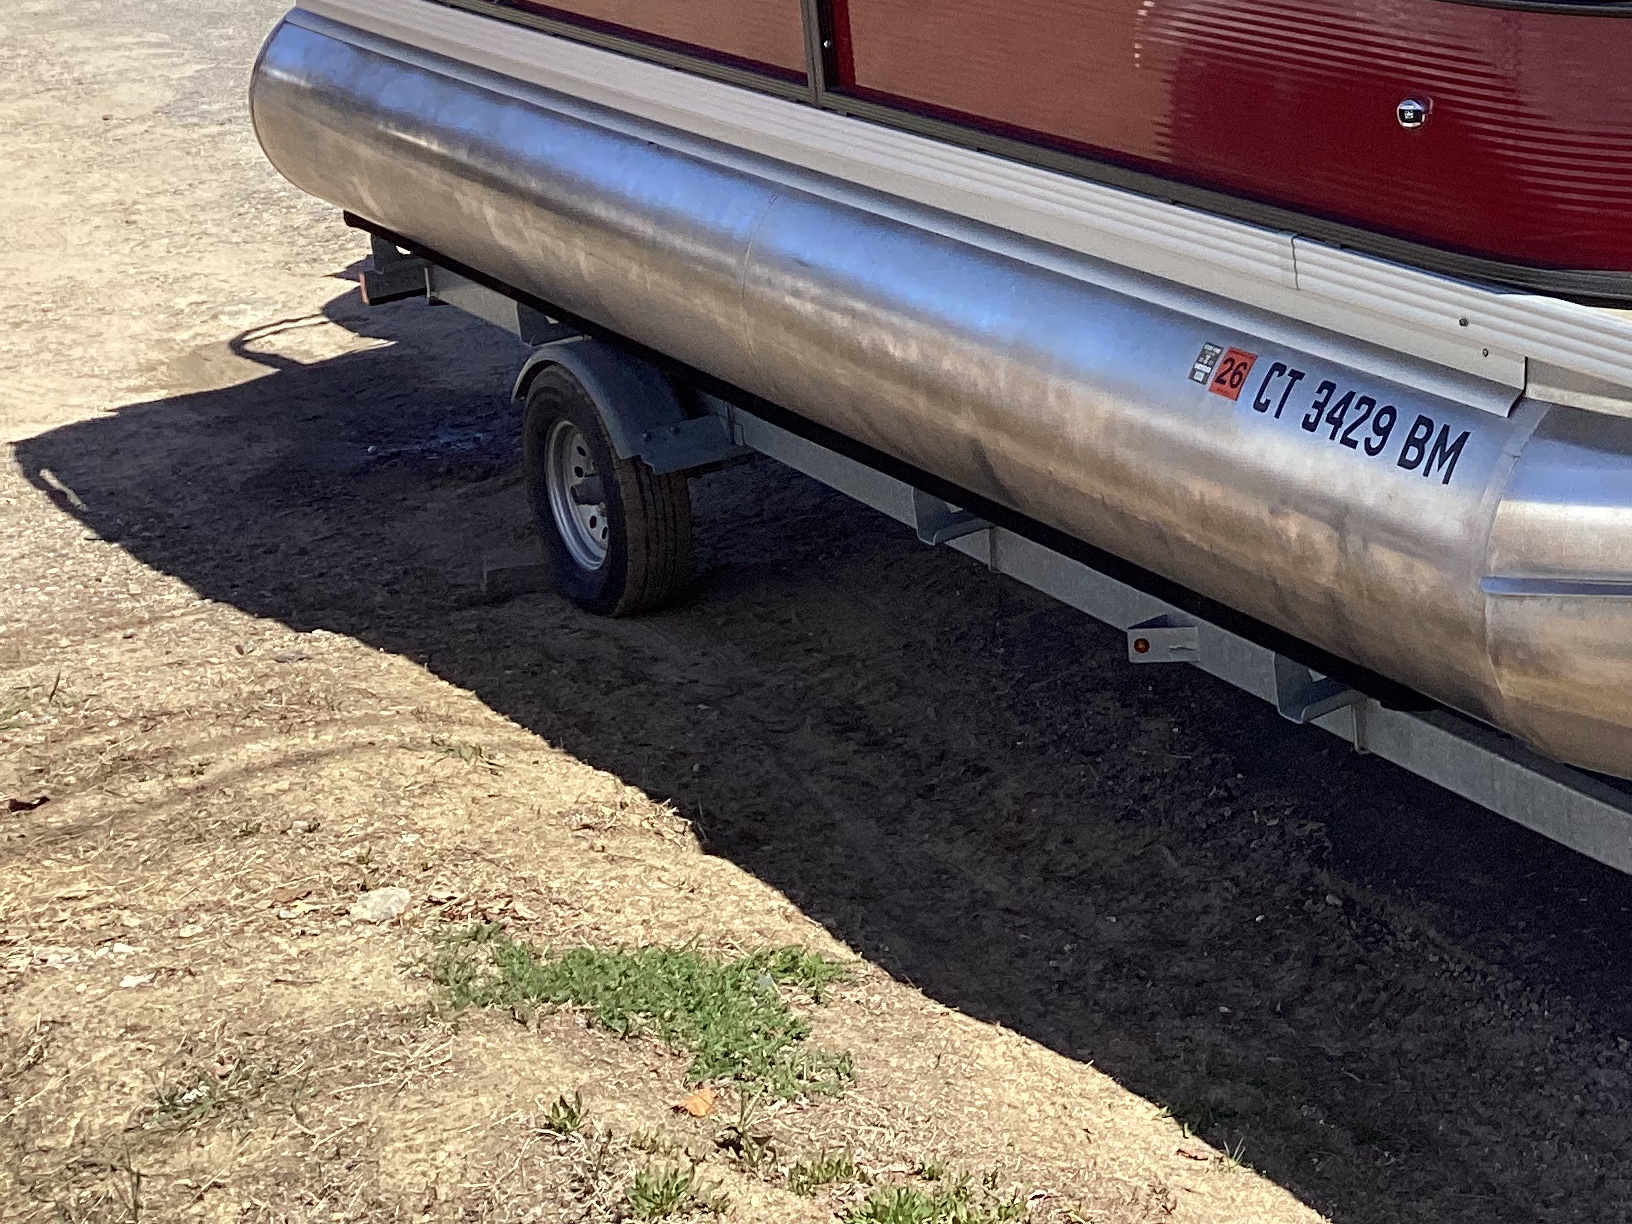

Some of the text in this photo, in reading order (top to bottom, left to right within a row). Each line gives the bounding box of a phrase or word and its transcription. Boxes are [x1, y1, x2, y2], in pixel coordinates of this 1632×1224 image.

[1214, 357, 1248, 389] 26
[1252, 361, 1306, 419] CT
[1301, 380, 1397, 457] 3429
[1396, 413, 1472, 485] BM
